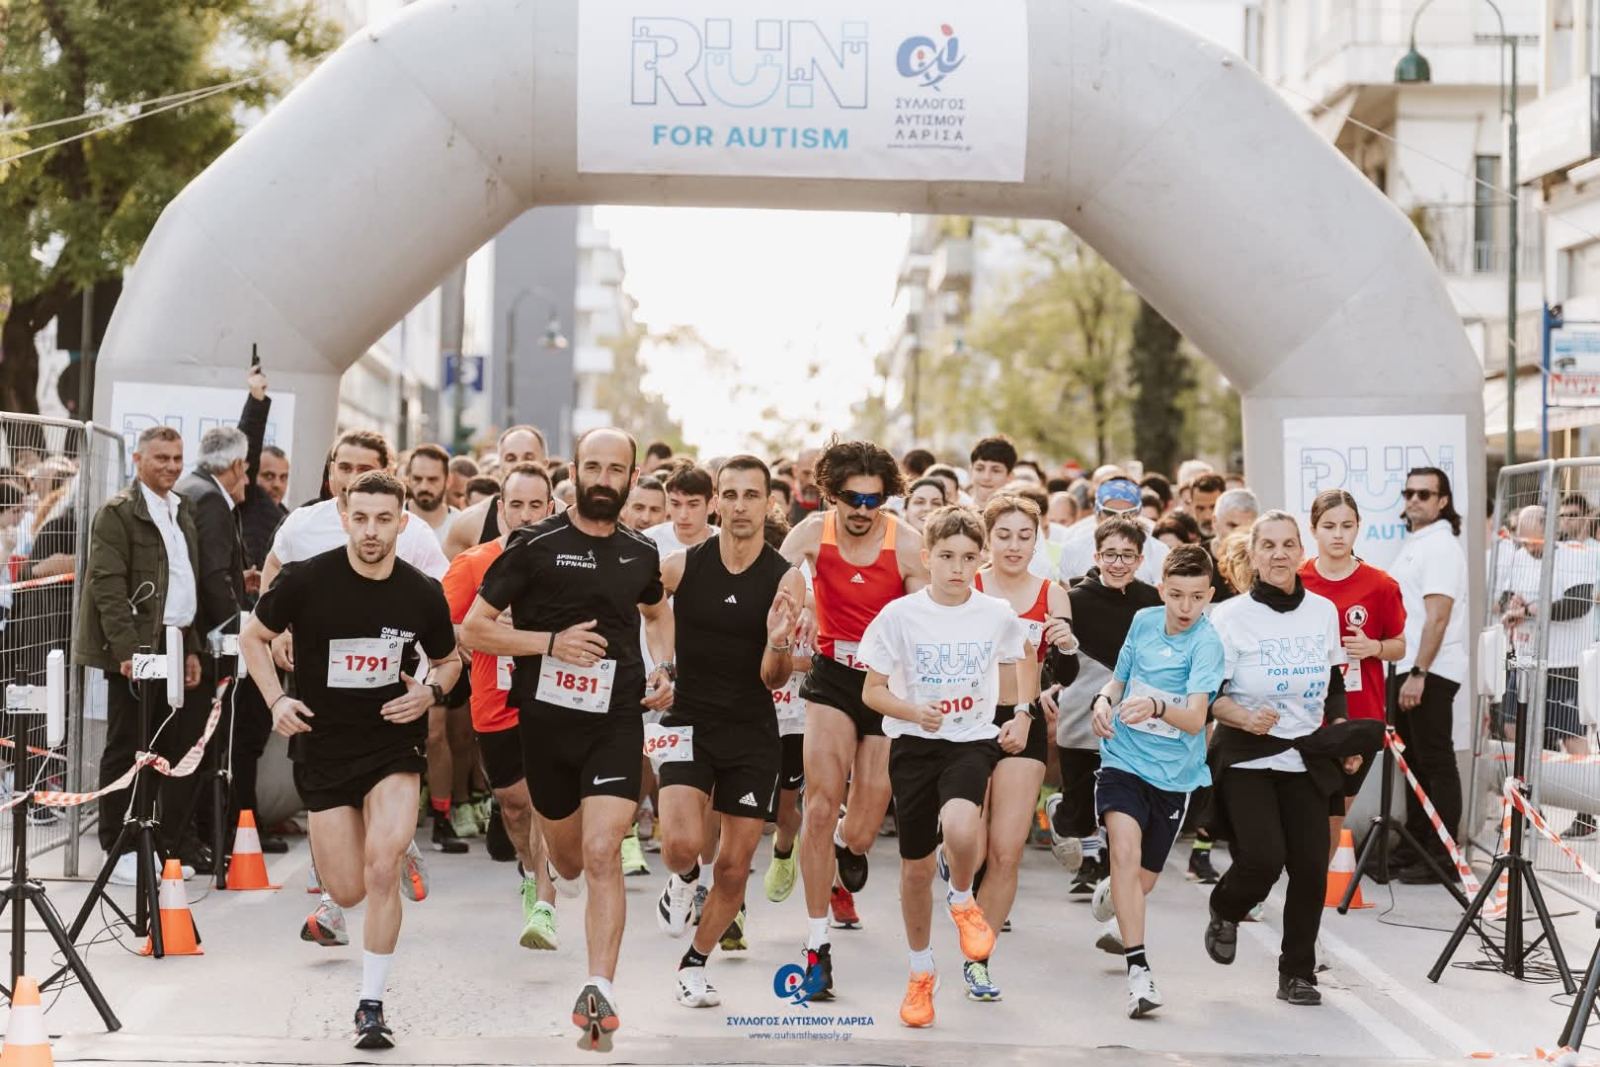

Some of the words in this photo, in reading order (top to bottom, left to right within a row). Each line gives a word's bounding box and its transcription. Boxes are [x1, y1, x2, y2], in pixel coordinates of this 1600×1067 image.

[631, 16, 869, 109] RUN
[895, 97, 965, 110] ΣΥΛΛΟΓΟΣ
[895, 114, 965, 126] ΑΥΤΙΣΜΟΥ
[652, 124, 713, 147] FOR
[726, 126, 849, 150] AUTISM
[895, 129, 963, 141] ΛΑΡΙΣΑ
[1366, 524, 1407, 541] AUT
[381, 626, 399, 636] ONE
[400, 630, 416, 639] WAY
[915, 642, 993, 675] RUN
[1259, 635, 1326, 666] RUN
[345, 655, 388, 671] 1791
[1267, 668, 1289, 676] FOR
[1292, 665, 1325, 675] AUTISM
[555, 671, 598, 694] 1831
[773, 691, 791, 704] 94
[940, 696, 973, 714] 010
[645, 734, 679, 753] 369
